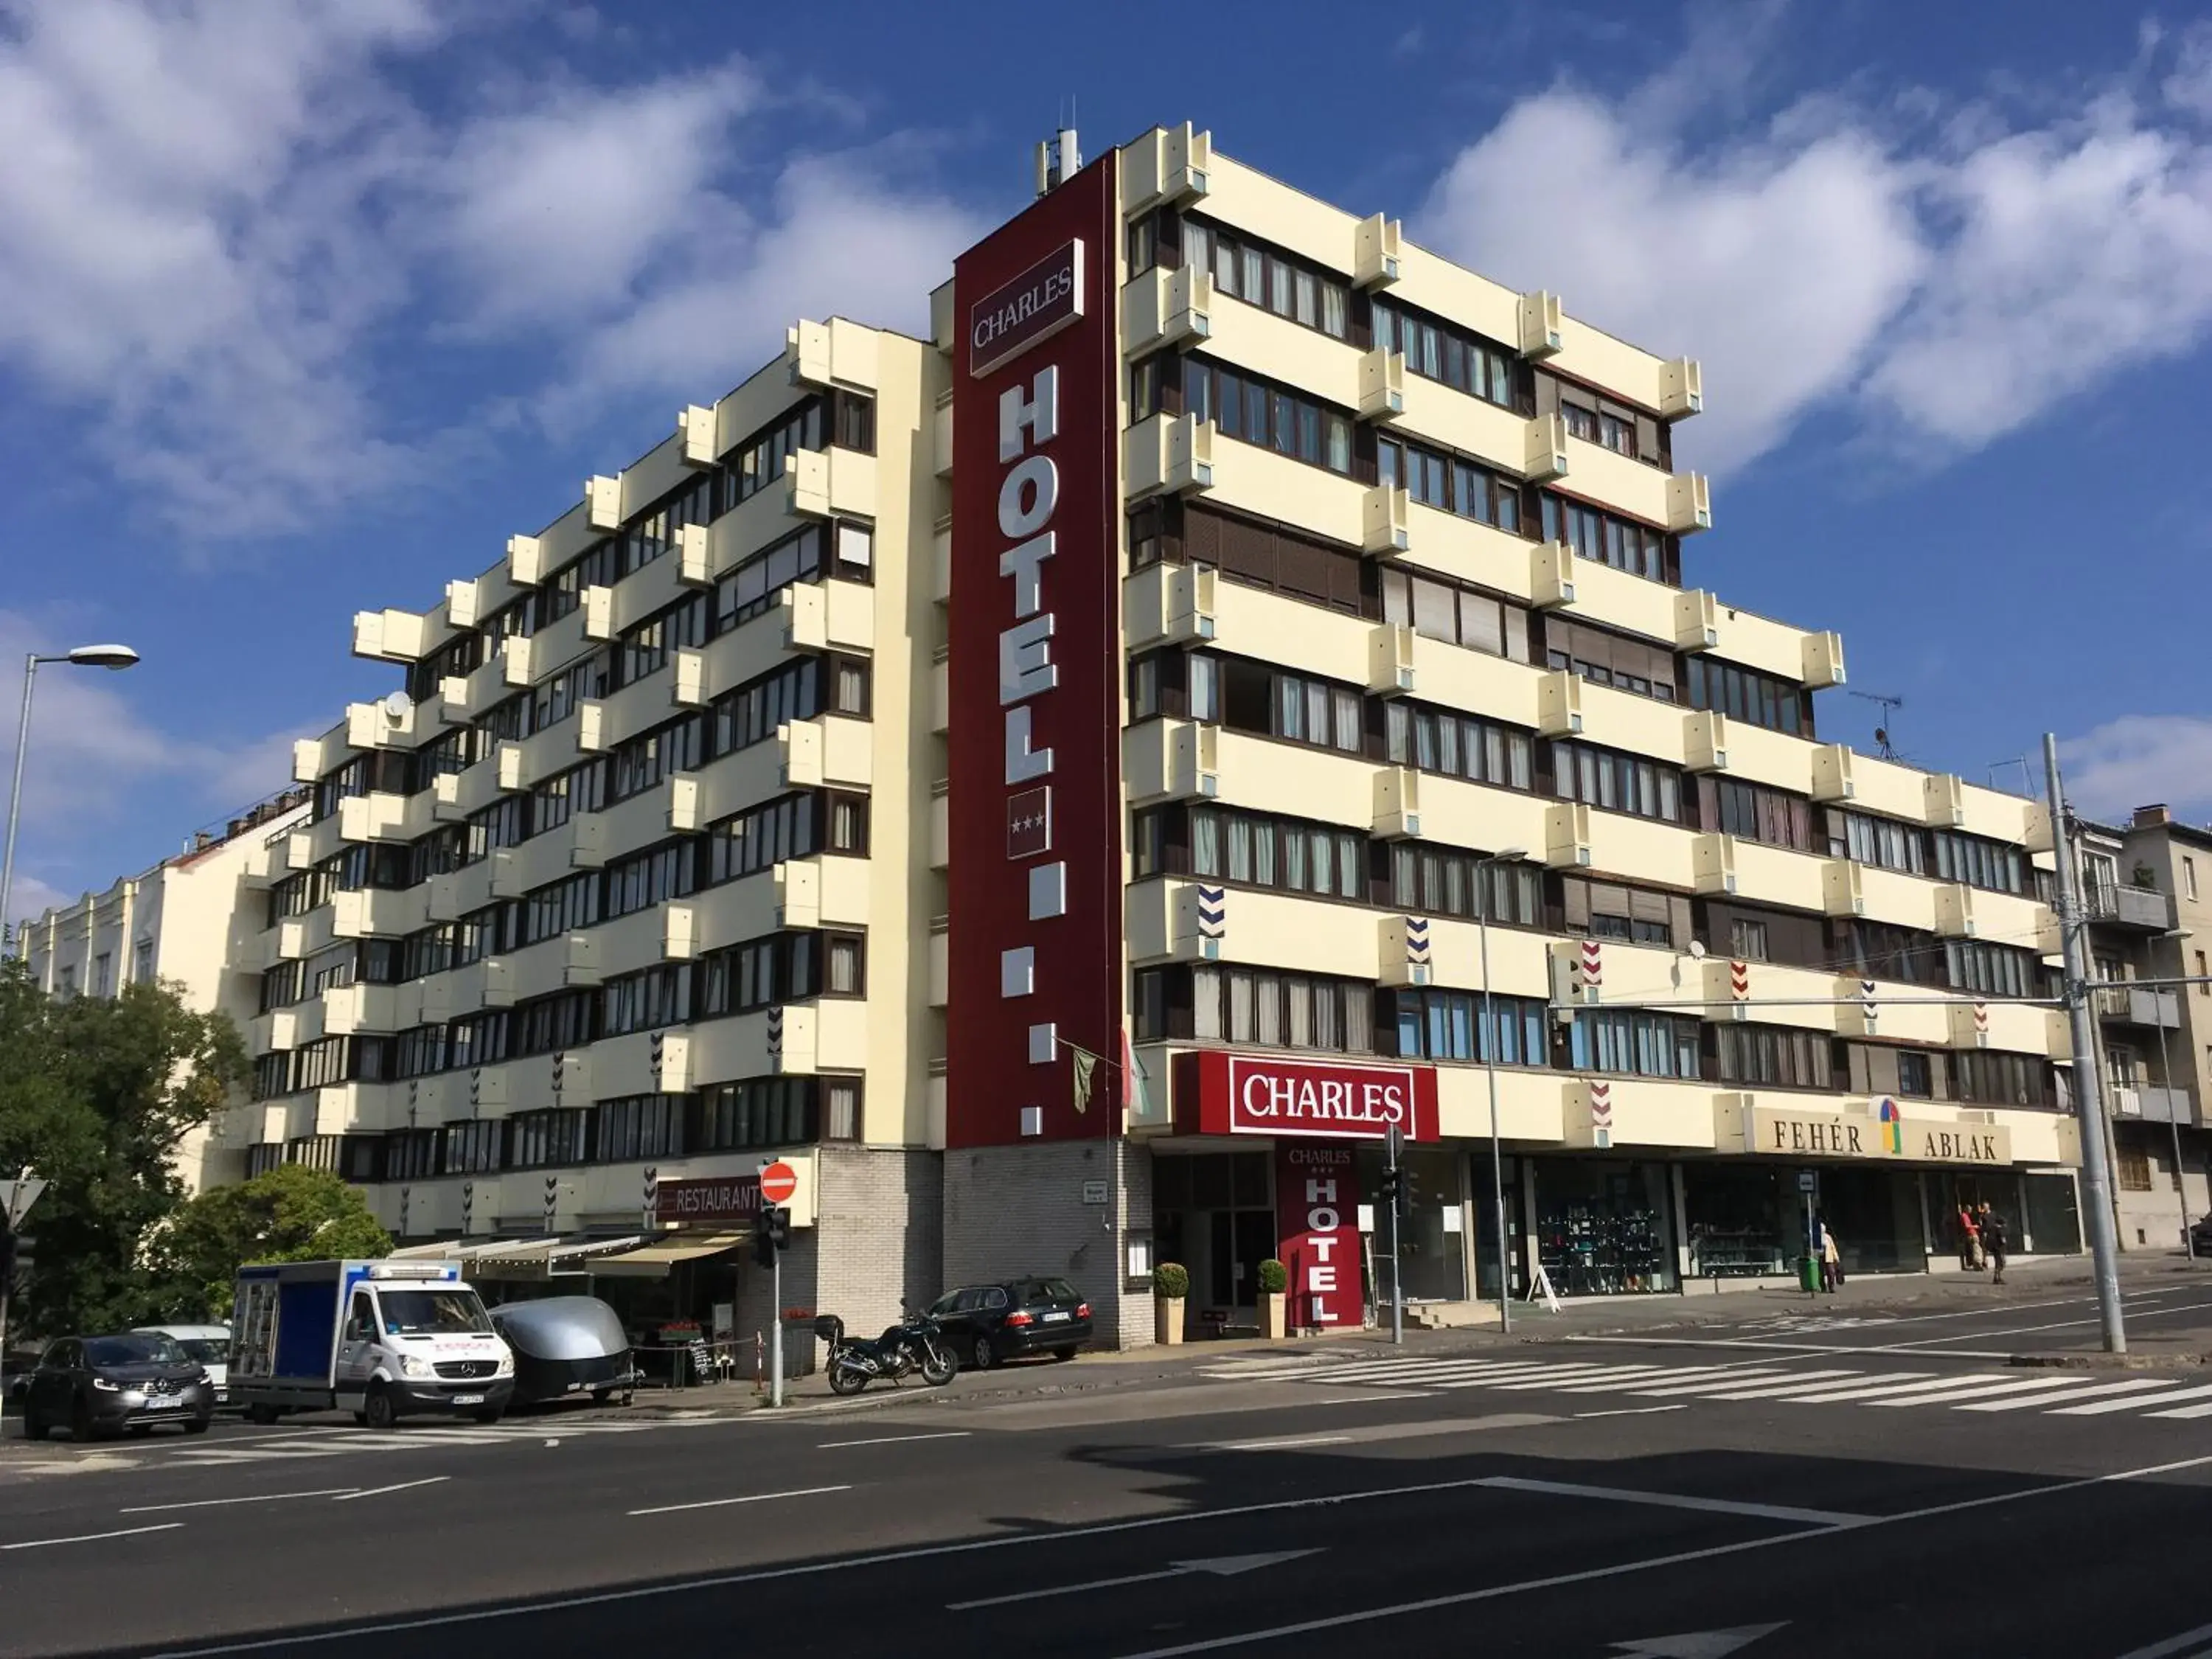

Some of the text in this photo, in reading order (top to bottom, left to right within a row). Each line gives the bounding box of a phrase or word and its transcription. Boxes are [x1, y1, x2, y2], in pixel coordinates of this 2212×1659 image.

[974, 266, 1071, 349] CHARLES
[998, 364, 1060, 786] HOTEL
[1242, 1074, 1404, 1124] CHARLES
[1289, 1149, 1351, 1165] CHARLES
[1773, 1116, 1997, 1161] FEHÉR ABLAK
[676, 1185, 759, 1212] RESTAURANT
[1306, 1178, 1340, 1321] HOTEL
